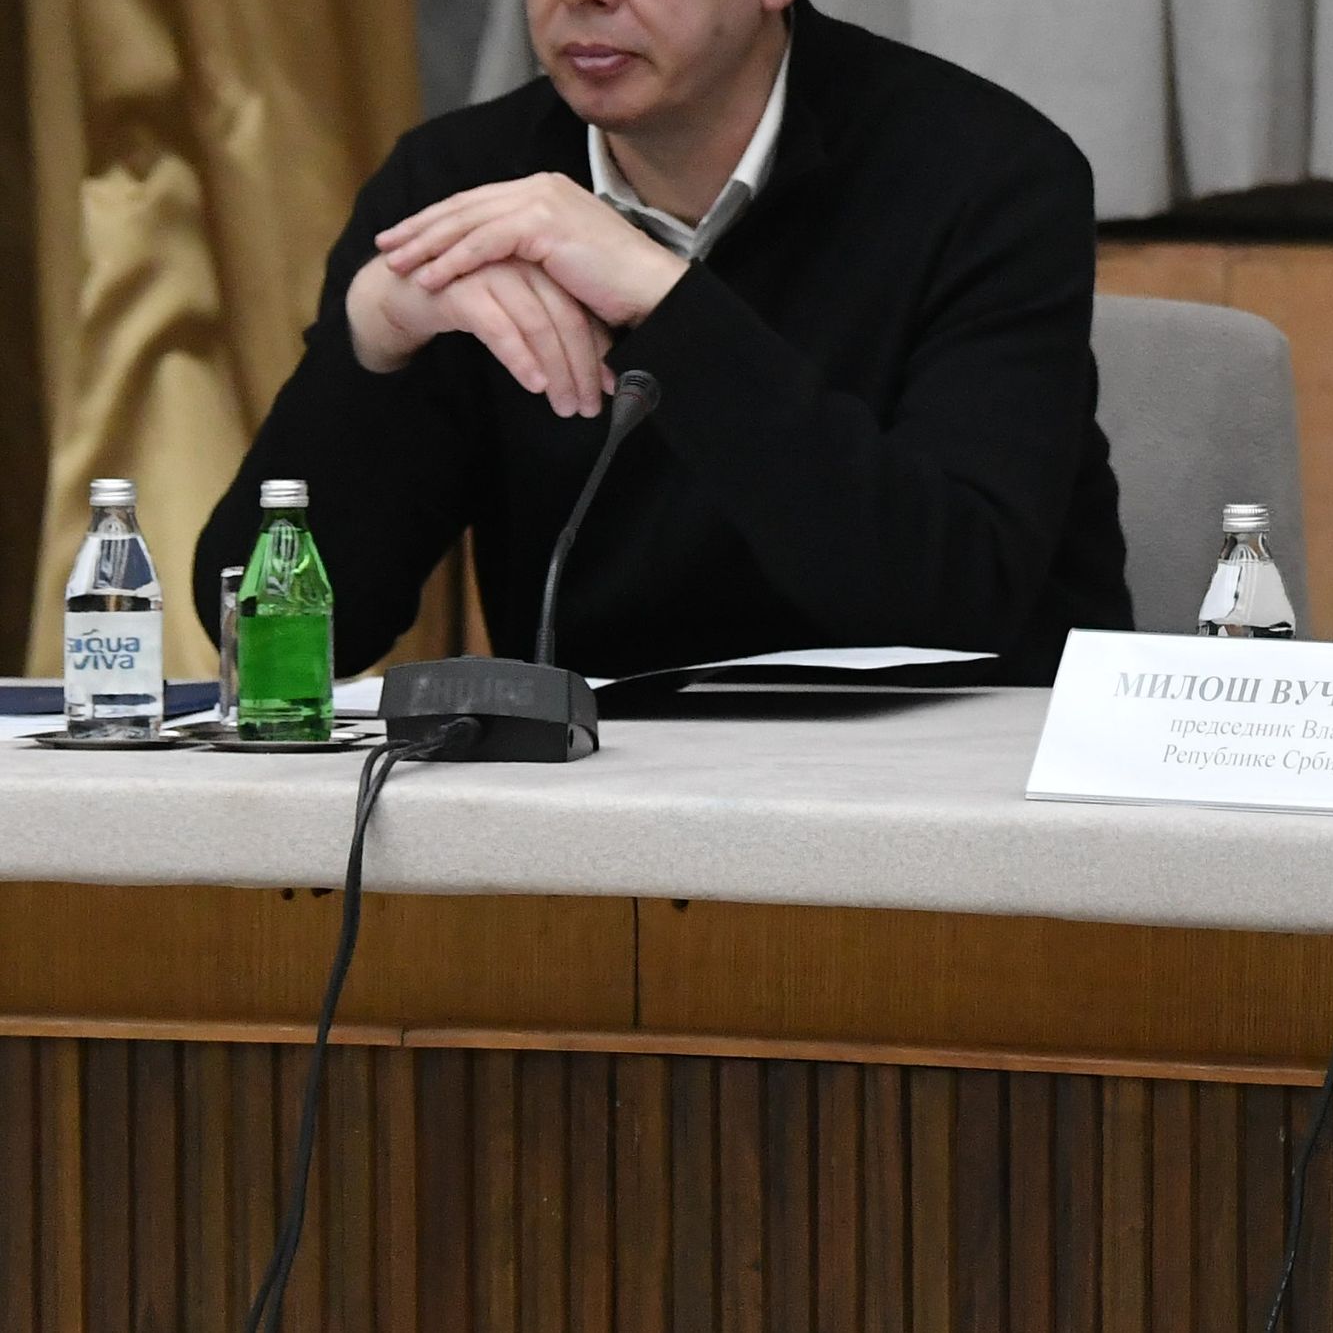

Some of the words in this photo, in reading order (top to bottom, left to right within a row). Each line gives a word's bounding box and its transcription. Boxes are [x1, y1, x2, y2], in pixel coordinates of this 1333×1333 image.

[73, 653, 135, 671] viva
[1113, 671, 1264, 704] МИЛОШ
[1169, 717, 1296, 739] председник
[1161, 742, 1277, 770] Републике
